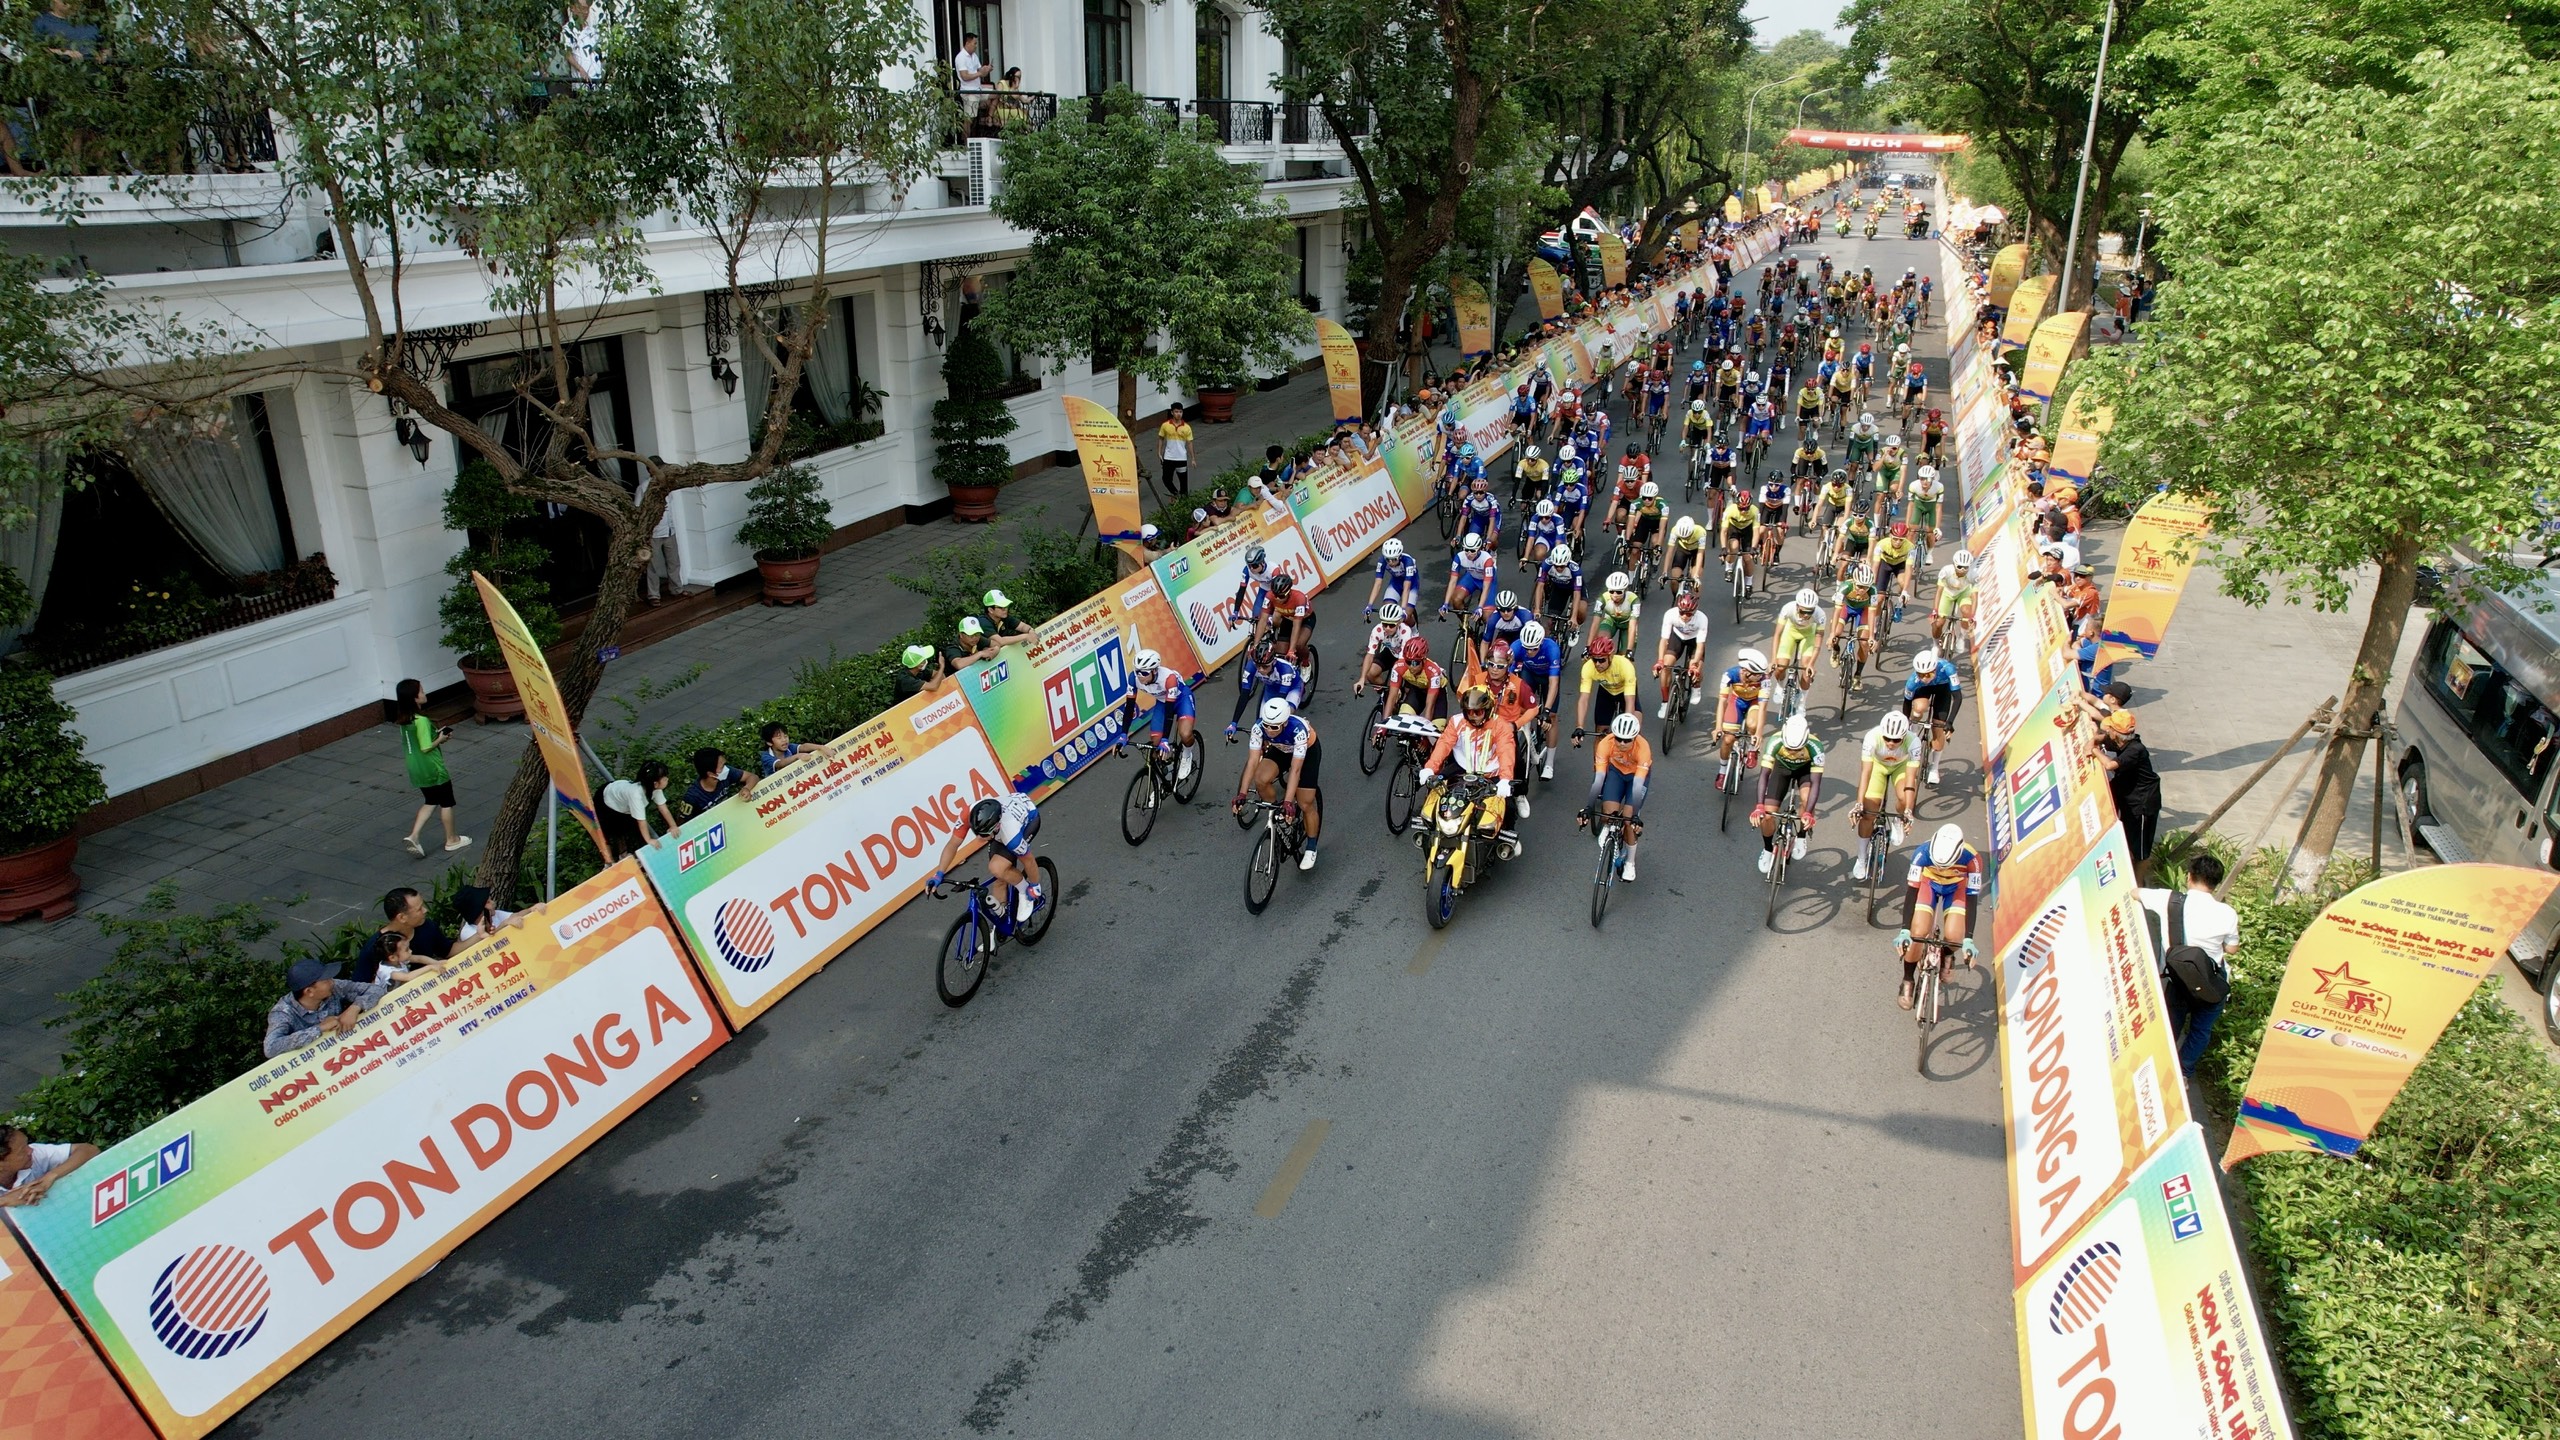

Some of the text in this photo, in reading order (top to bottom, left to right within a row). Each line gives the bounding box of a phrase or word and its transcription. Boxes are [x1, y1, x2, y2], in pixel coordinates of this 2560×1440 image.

[1326, 488, 1400, 554] TON DONG A
[1168, 556, 1189, 580] HTV
[1291, 549, 1313, 580] A
[1128, 583, 1156, 604] TON DONG A
[1025, 643, 1045, 661] NON
[1043, 629, 1068, 650] SÔNG
[1080, 610, 1100, 629] MỘT
[979, 660, 1009, 692] HTV
[1992, 667, 2022, 725] DONG
[922, 697, 961, 726] TON DONG A
[755, 793, 787, 819] NON
[785, 769, 823, 802] SÔNG
[845, 740, 875, 767] MỘT
[676, 821, 726, 874] HTV
[769, 768, 999, 938] TON DONG A
[1016, 841, 1027, 854] 117
[2095, 850, 2116, 888] HTV
[1970, 875, 1980, 885] 46
[572, 887, 639, 935] TON DONG A
[2108, 903, 2121, 931] NON
[2325, 912, 2356, 926] NON
[2360, 919, 2399, 936] SÔNG
[2433, 936, 2467, 953] MỘT
[2113, 926, 2130, 960] SÔNG
[246, 1070, 273, 1094] CUỘC
[269, 1062, 288, 1079] ĐUA
[287, 1056, 300, 1069] XE
[298, 1046, 318, 1064] ĐẠP
[314, 1034, 337, 1053] TOÀN
[356, 1010, 381, 1029] TRANH
[379, 1001, 395, 1016] CÚP
[393, 986, 422, 1008] TRUYỀN
[419, 976, 438, 993] HÌNH
[457, 956, 473, 971] PHỐ
[470, 950, 483, 963] HỒ
[481, 945, 494, 958] CHÍ
[492, 936, 510, 951] MINH
[458, 986, 528, 1036] HTV TÔN ĐÔNG
[2123, 982, 2141, 1015] MỘT
[2291, 998, 2407, 1034] CÚP TRUYỀN HÌNH
[258, 1069, 320, 1114] NON
[318, 1025, 390, 1080] SÔNG
[435, 967, 488, 1011] MỘT
[2273, 1020, 2324, 1038] HTV
[2350, 1040, 2370, 1049] TON
[2371, 1045, 2400, 1057] DONG
[271, 1105, 299, 1127] CHÀO
[325, 1083, 339, 1095] 70
[357, 1054, 383, 1076] CHIẾN
[425, 1018, 444, 1035] BIÊN
[2022, 951, 2080, 1236] TON DONG A
[268, 984, 691, 1285] TON DONG A
[2138, 1079, 2158, 1141] TON DONG A
[96, 1132, 192, 1225] HTV
[2163, 1171, 2202, 1240] HTV
[2198, 1286, 2241, 1408] NON SÔNG
